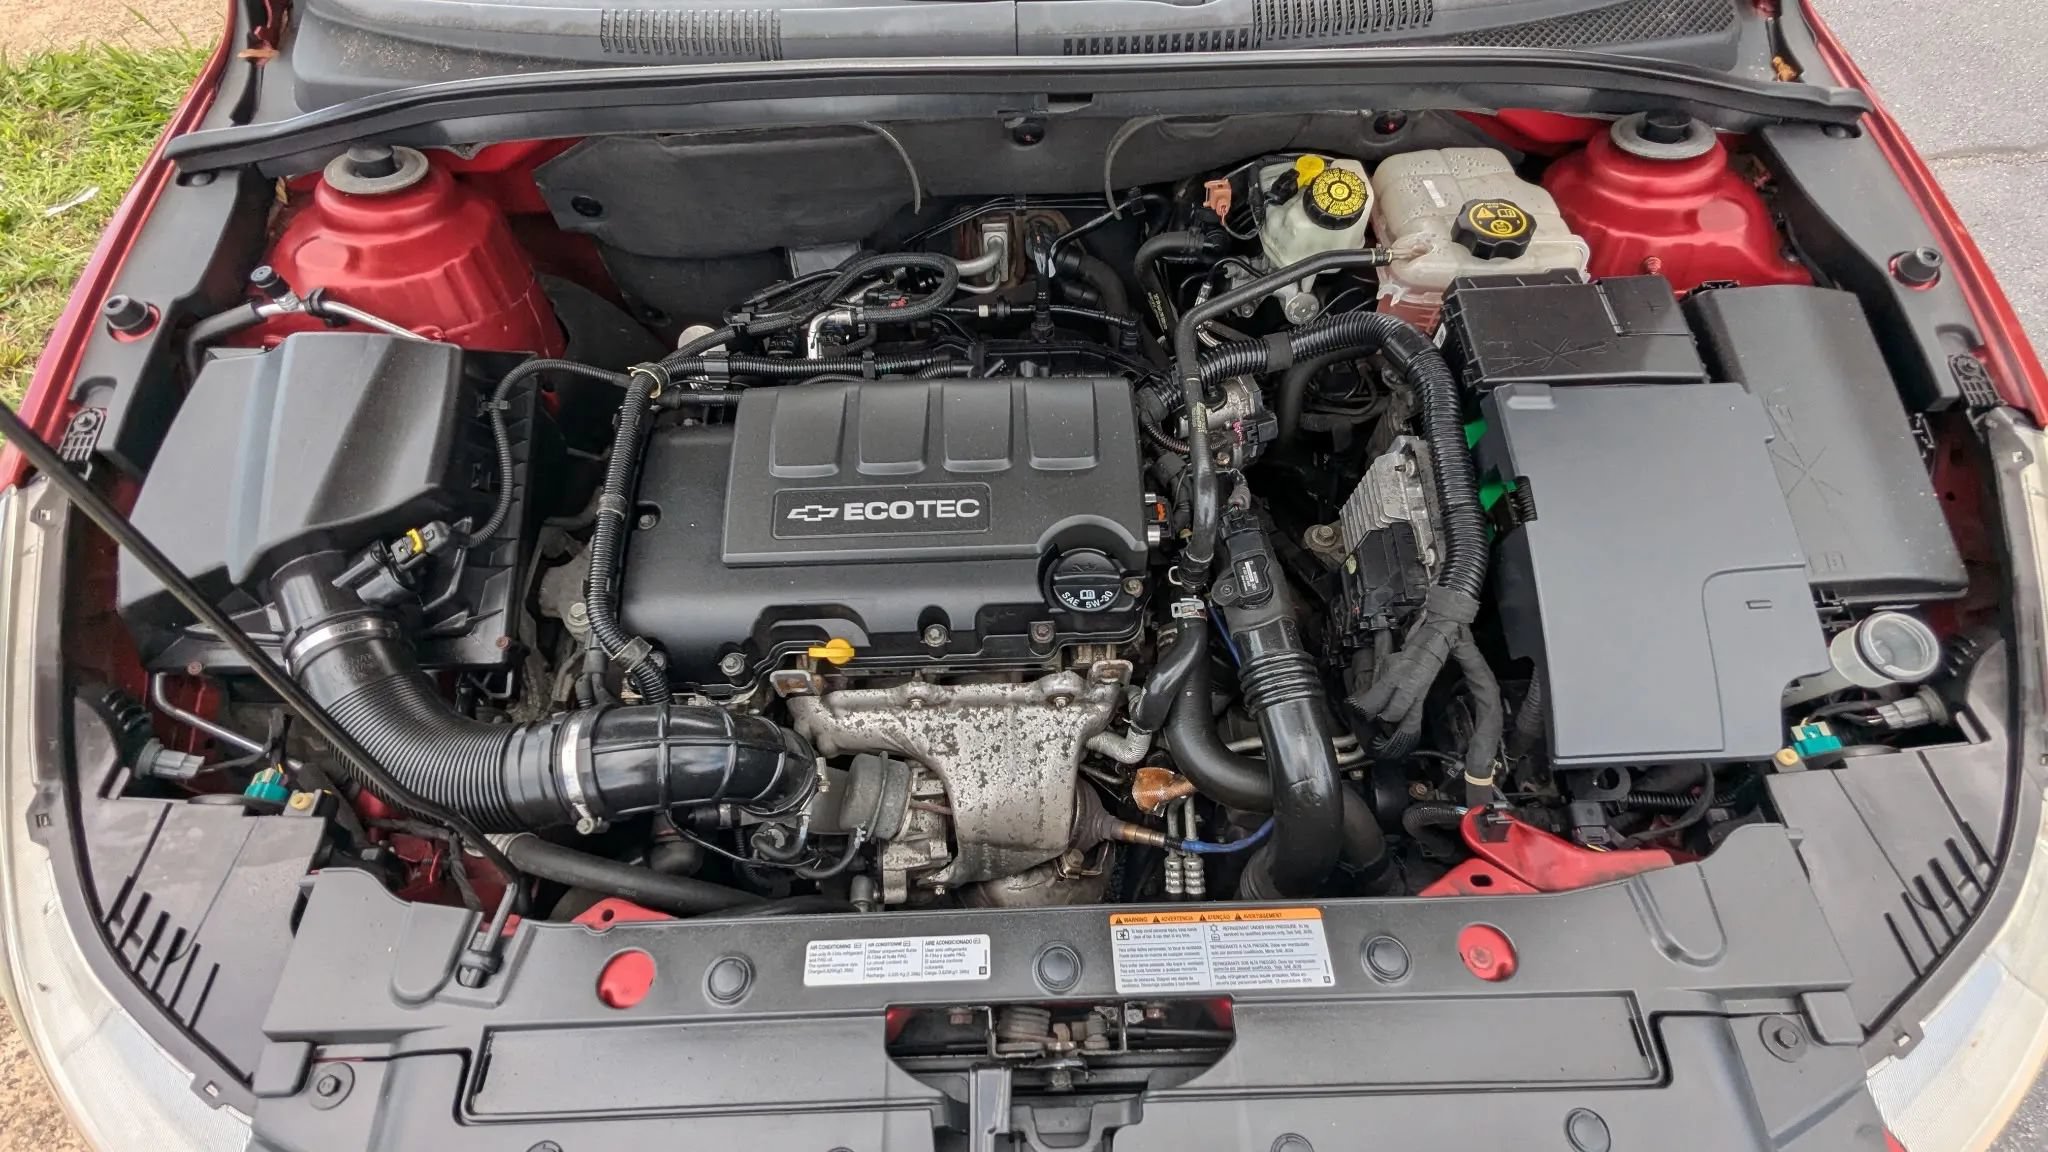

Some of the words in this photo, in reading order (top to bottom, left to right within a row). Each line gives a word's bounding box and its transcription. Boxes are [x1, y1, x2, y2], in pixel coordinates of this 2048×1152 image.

[843, 499, 980, 521] ECOTEC
[1061, 591, 1080, 607] SAE
[1085, 590, 1114, 609] 5W-30
